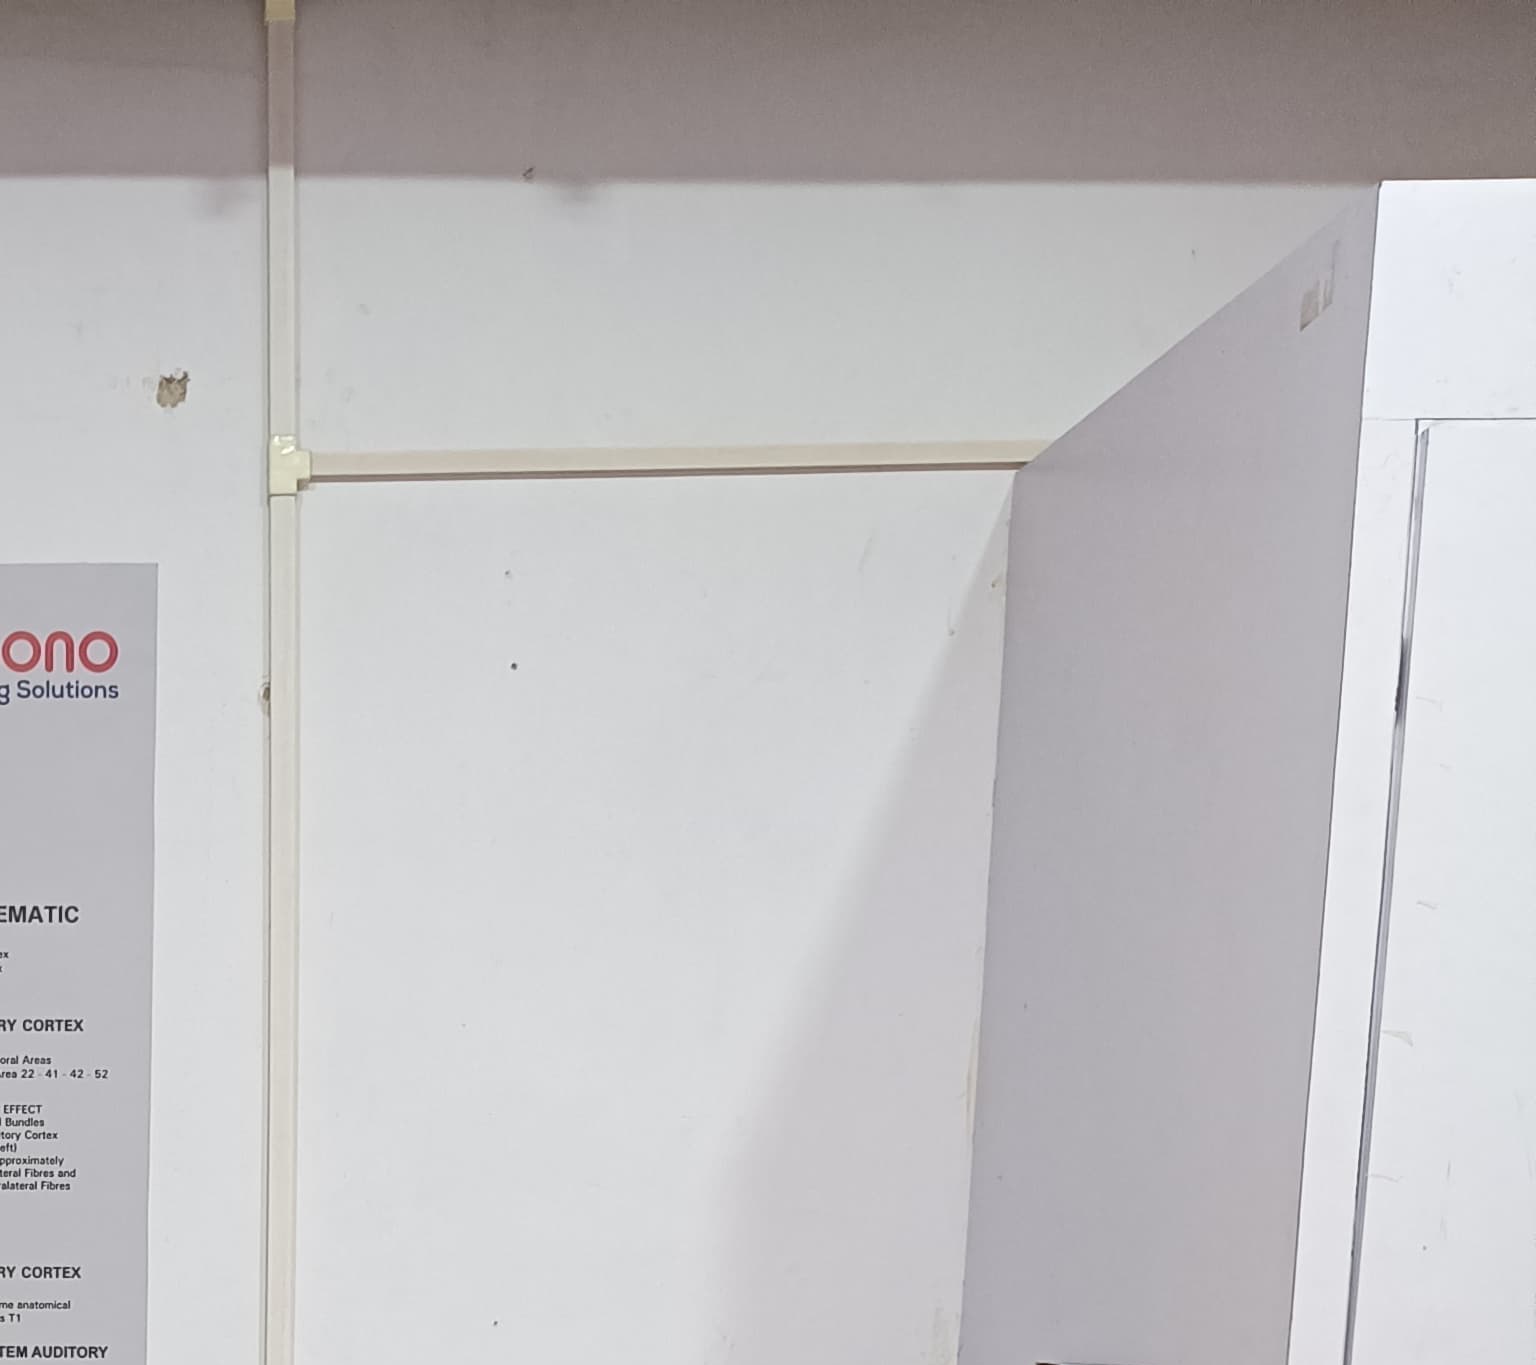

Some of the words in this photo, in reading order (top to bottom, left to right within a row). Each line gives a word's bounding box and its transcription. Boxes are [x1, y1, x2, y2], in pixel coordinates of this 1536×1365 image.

[17, 680, 119, 699] Solutions
[22, 1019, 84, 1032] CORTEX
[22, 1055, 52, 1065] Areas
[21, 1069, 34, 1079] 22
[45, 1069, 58, 1079] 41
[70, 1069, 84, 1079] 42
[94, 1069, 109, 1079] 52
[3, 1104, 43, 1114] EFFECT
[5, 1117, 45, 1127] Bundles
[24, 1130, 58, 1140] Cortex
[24, 1168, 55, 1178] Fibres
[58, 1168, 77, 1178] and
[41, 1181, 71, 1190] Fibres
[21, 1266, 82, 1279] CORTEX
[17, 1300, 71, 1310] anatomical
[8, 1314, 21, 1323] T1
[32, 1346, 108, 1358] AUDITORY
